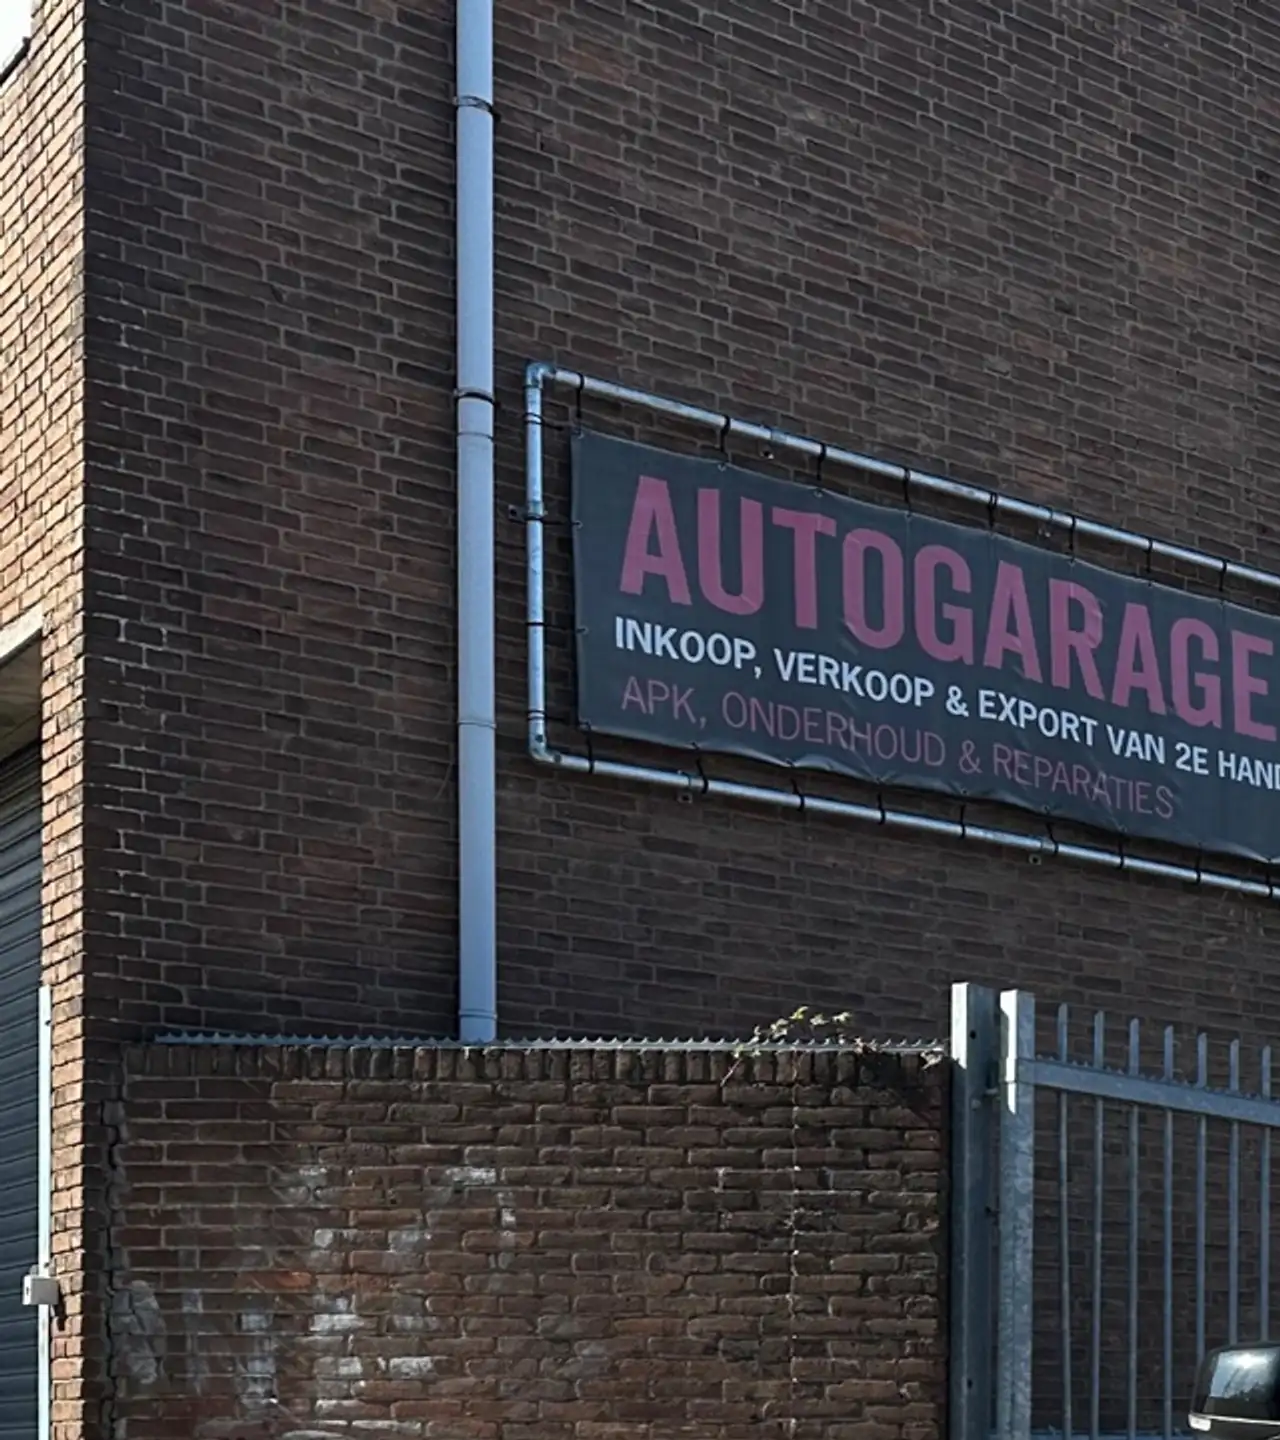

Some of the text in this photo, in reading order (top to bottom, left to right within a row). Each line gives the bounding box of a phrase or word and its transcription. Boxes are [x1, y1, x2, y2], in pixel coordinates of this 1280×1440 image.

[619, 475, 1277, 742] AUTOGARAGE
[615, 616, 762, 679] INKOOP,
[774, 648, 935, 706] VERKOOP
[945, 685, 969, 717] &
[978, 690, 1098, 746] EXPORT
[1106, 724, 1166, 764] VAN
[1174, 742, 1209, 775] 2E
[621, 676, 1175, 819] APK, ONDERHOUD & REPARATIES
